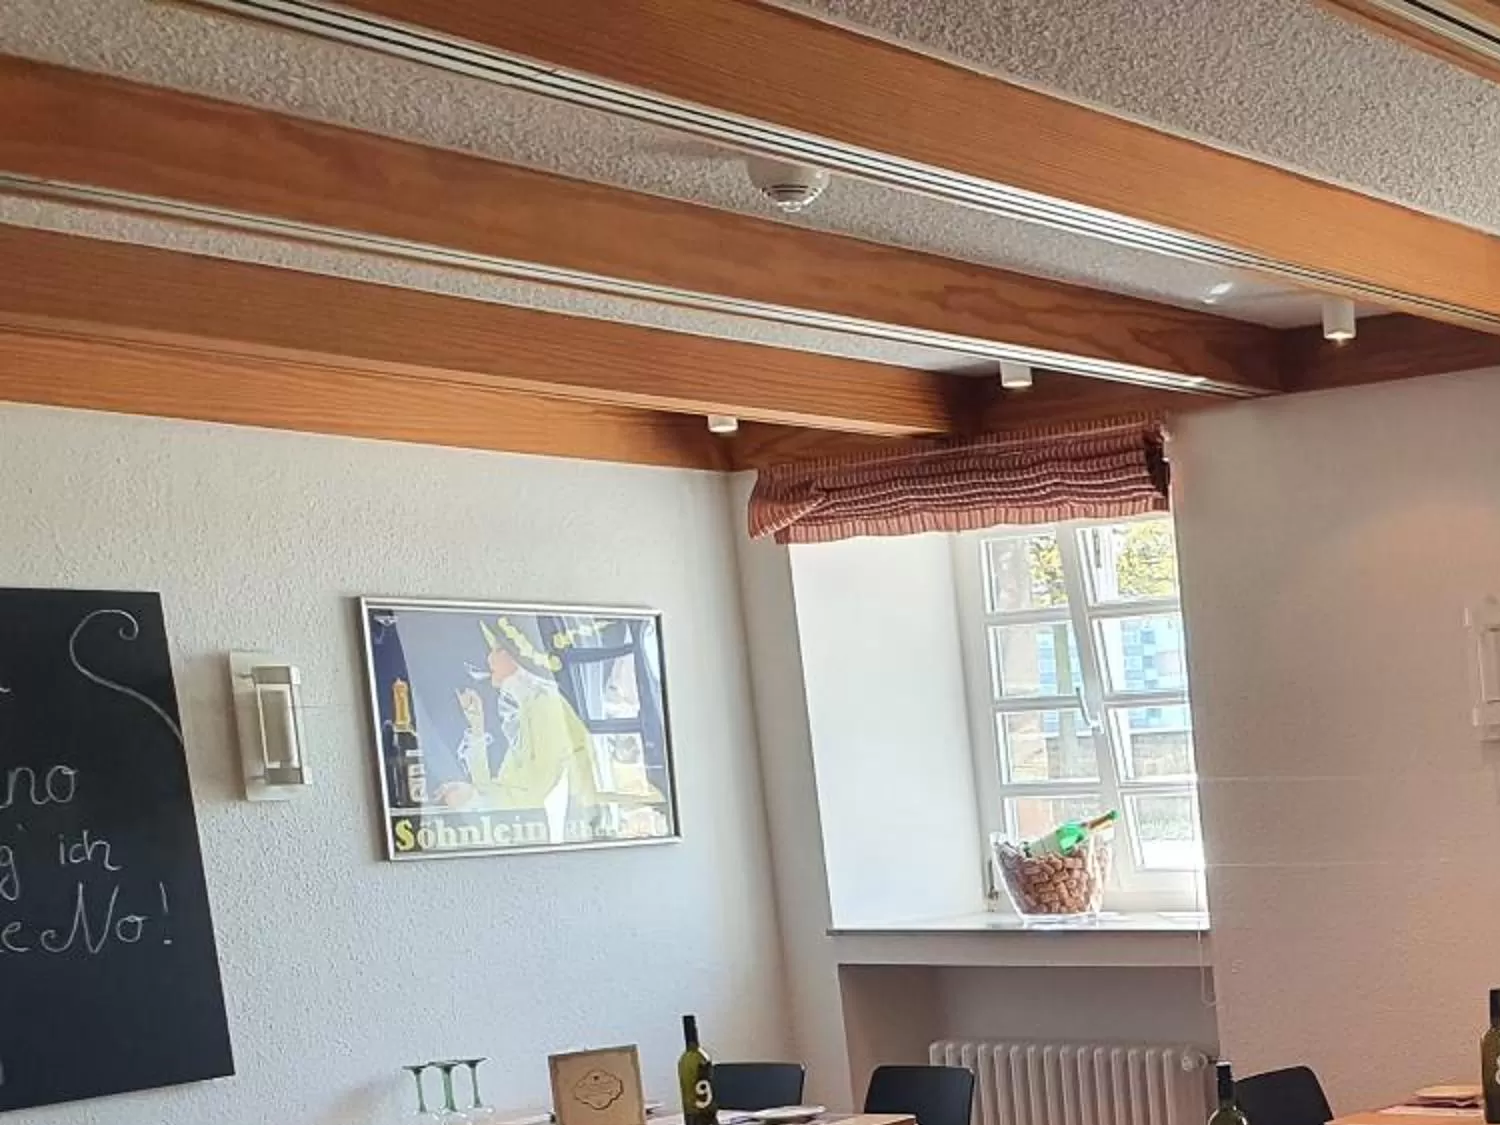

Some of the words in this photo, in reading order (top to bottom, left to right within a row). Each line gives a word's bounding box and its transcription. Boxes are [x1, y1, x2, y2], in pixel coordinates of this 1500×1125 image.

[0, 765, 78, 809] no
[58, 828, 121, 871] ich
[695, 1079, 713, 1109] 9
